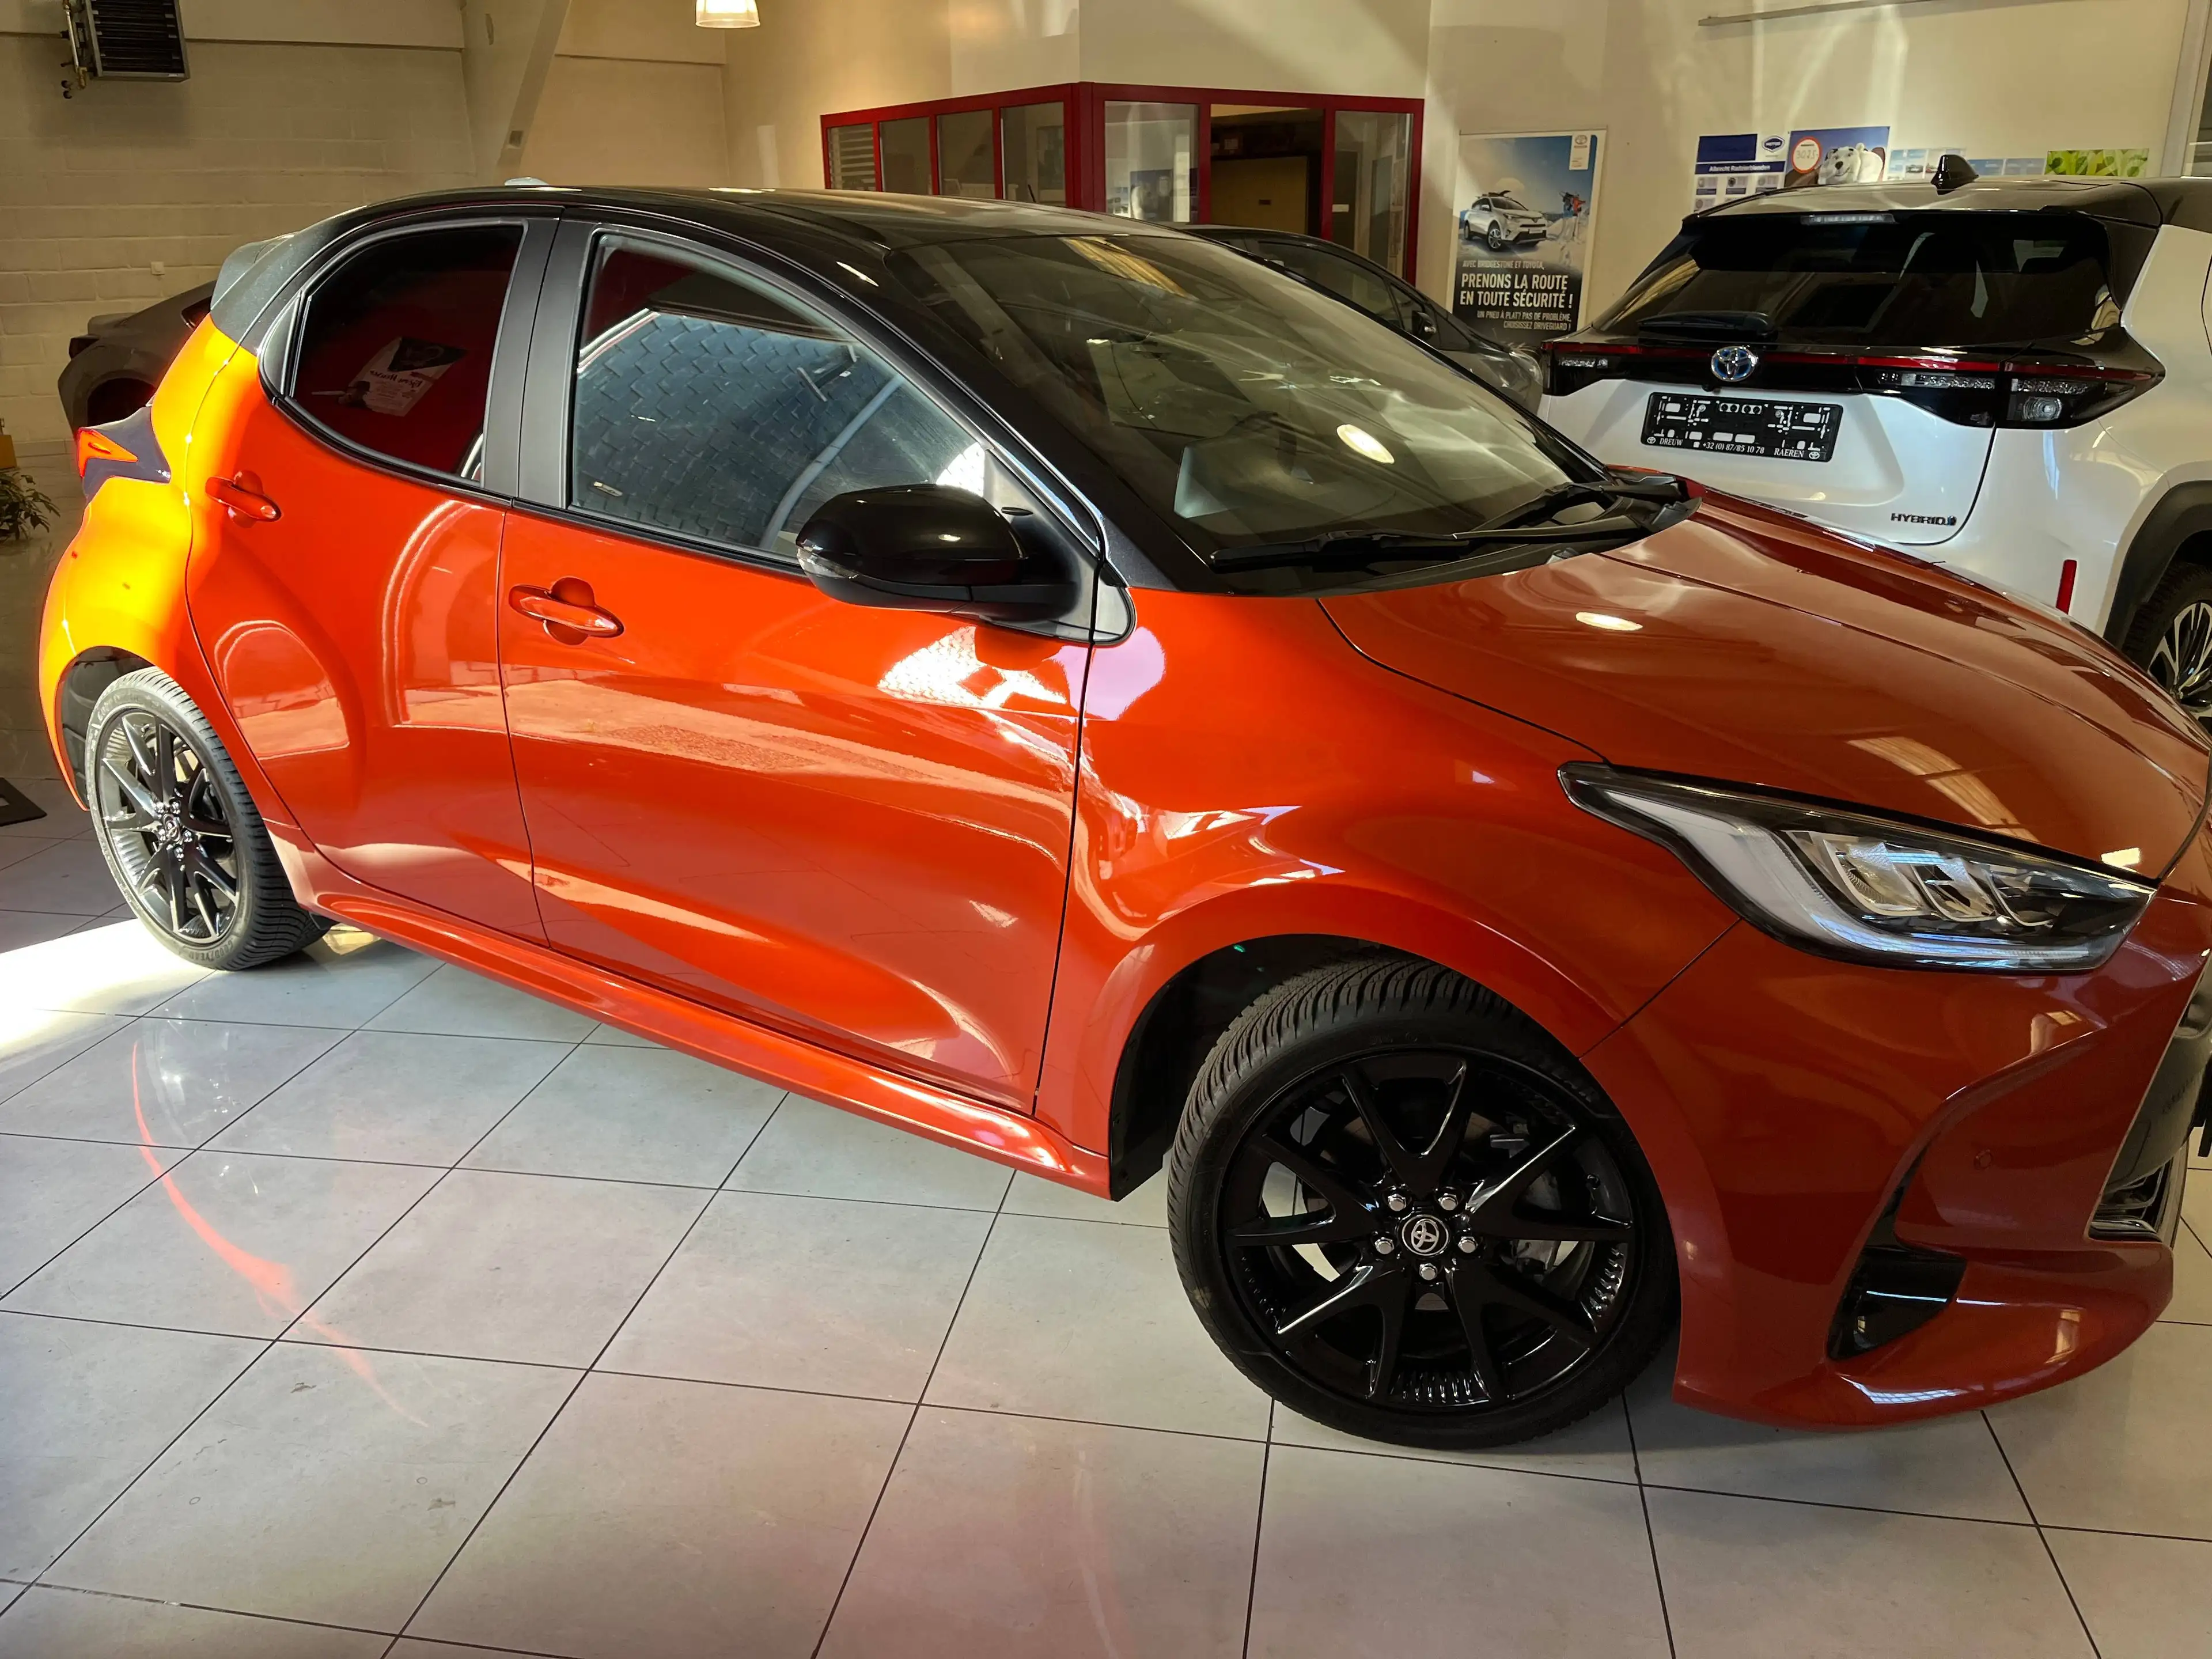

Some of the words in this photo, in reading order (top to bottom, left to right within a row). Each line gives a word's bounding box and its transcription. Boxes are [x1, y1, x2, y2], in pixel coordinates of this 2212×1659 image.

[1477, 260, 1514, 268] BRIDGESTONE
[1461, 273, 1512, 289] PRENONS
[1514, 274, 1528, 289] LA
[1532, 275, 1569, 290] ROUTE
[1460, 291, 1474, 305] EN
[1477, 291, 1510, 306] TOUTE
[1513, 289, 1566, 308] SÉCURITÉ
[1569, 294, 1573, 308] !
[1477, 310, 1485, 318] UN
[1485, 310, 1499, 319] PNEU
[1521, 312, 1533, 320] PAS
[1533, 312, 1541, 320] DE
[1533, 322, 1567, 331] DRIVEGUARD
[1659, 437, 1684, 446] DREUW
[1702, 442, 1714, 450] +32
[1715, 442, 1725, 450] (0)
[1725, 444, 1745, 453] 87/85
[1755, 446, 1765, 454] 78
[1774, 448, 1805, 459] RAEREN
[1891, 513, 1946, 525] HYBRID
